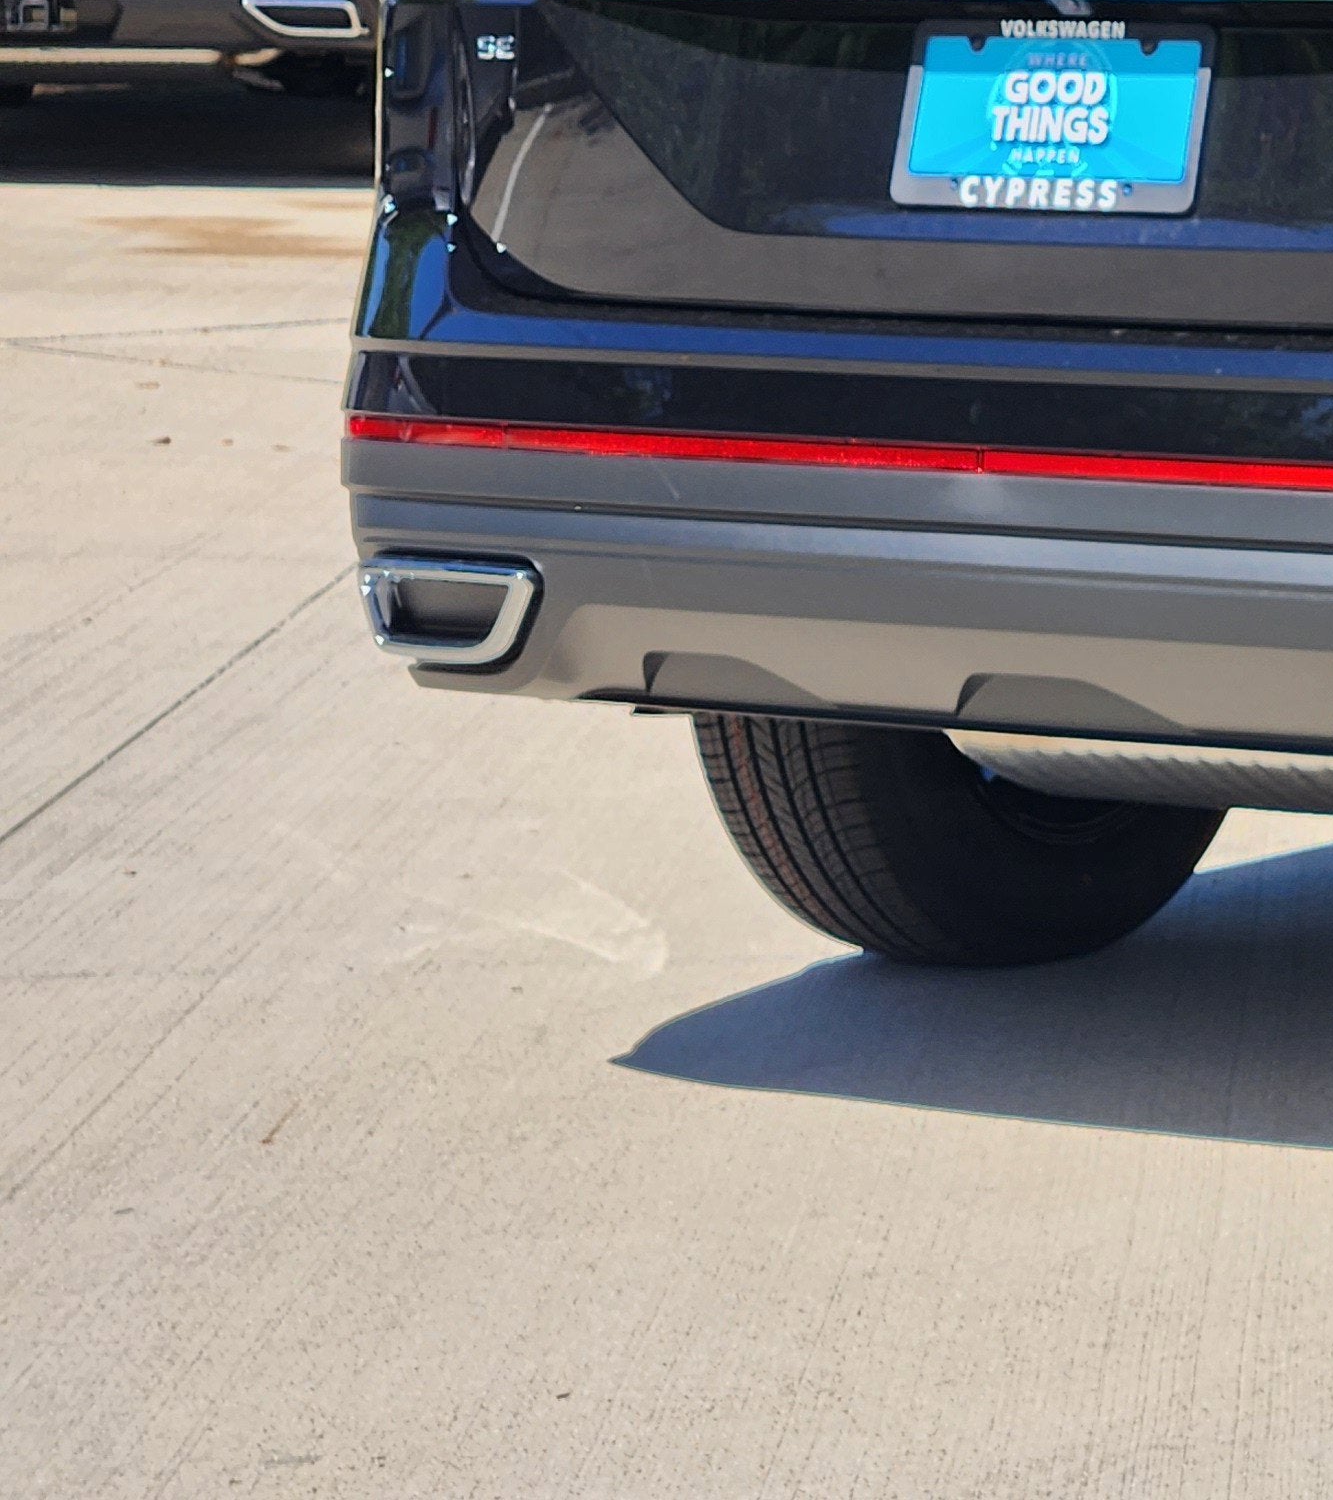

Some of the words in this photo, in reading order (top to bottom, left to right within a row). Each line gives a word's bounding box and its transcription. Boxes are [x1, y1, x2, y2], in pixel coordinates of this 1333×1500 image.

[1000, 18, 1126, 40] VOLKSWAGEN
[476, 35, 515, 60] SE
[1027, 51, 1089, 67] WHERE
[1004, 70, 1107, 106] GOOD
[992, 105, 1109, 145] THINGS
[1009, 146, 1081, 165] HAPPEN
[958, 175, 1118, 211] CYPRESS
